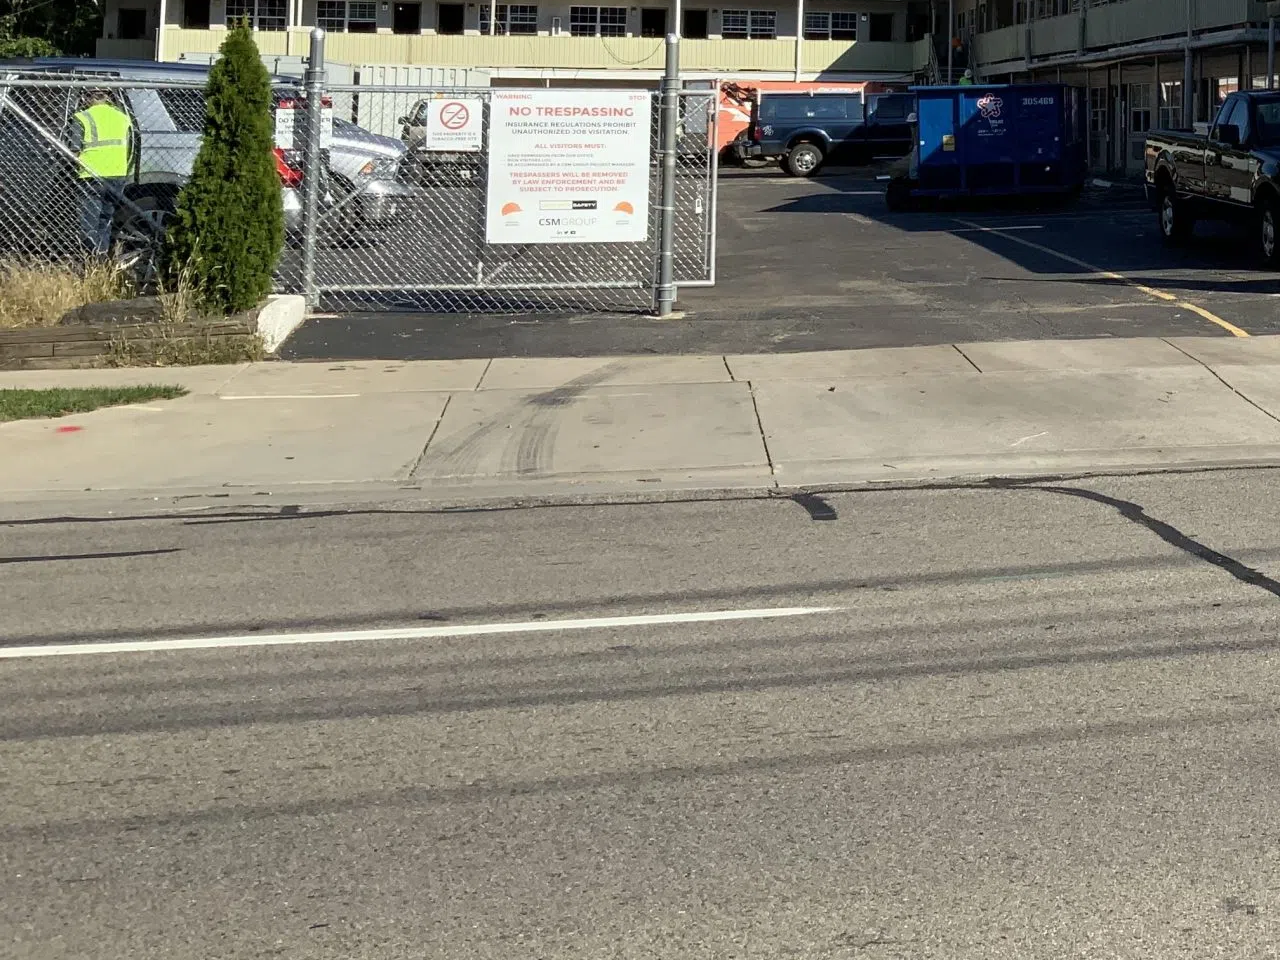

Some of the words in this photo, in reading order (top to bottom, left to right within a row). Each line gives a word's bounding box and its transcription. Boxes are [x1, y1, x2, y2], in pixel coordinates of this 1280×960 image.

[509, 106, 532, 116] NO
[536, 106, 634, 117] TRESPASSING
[538, 217, 597, 226] CSMGROUP
